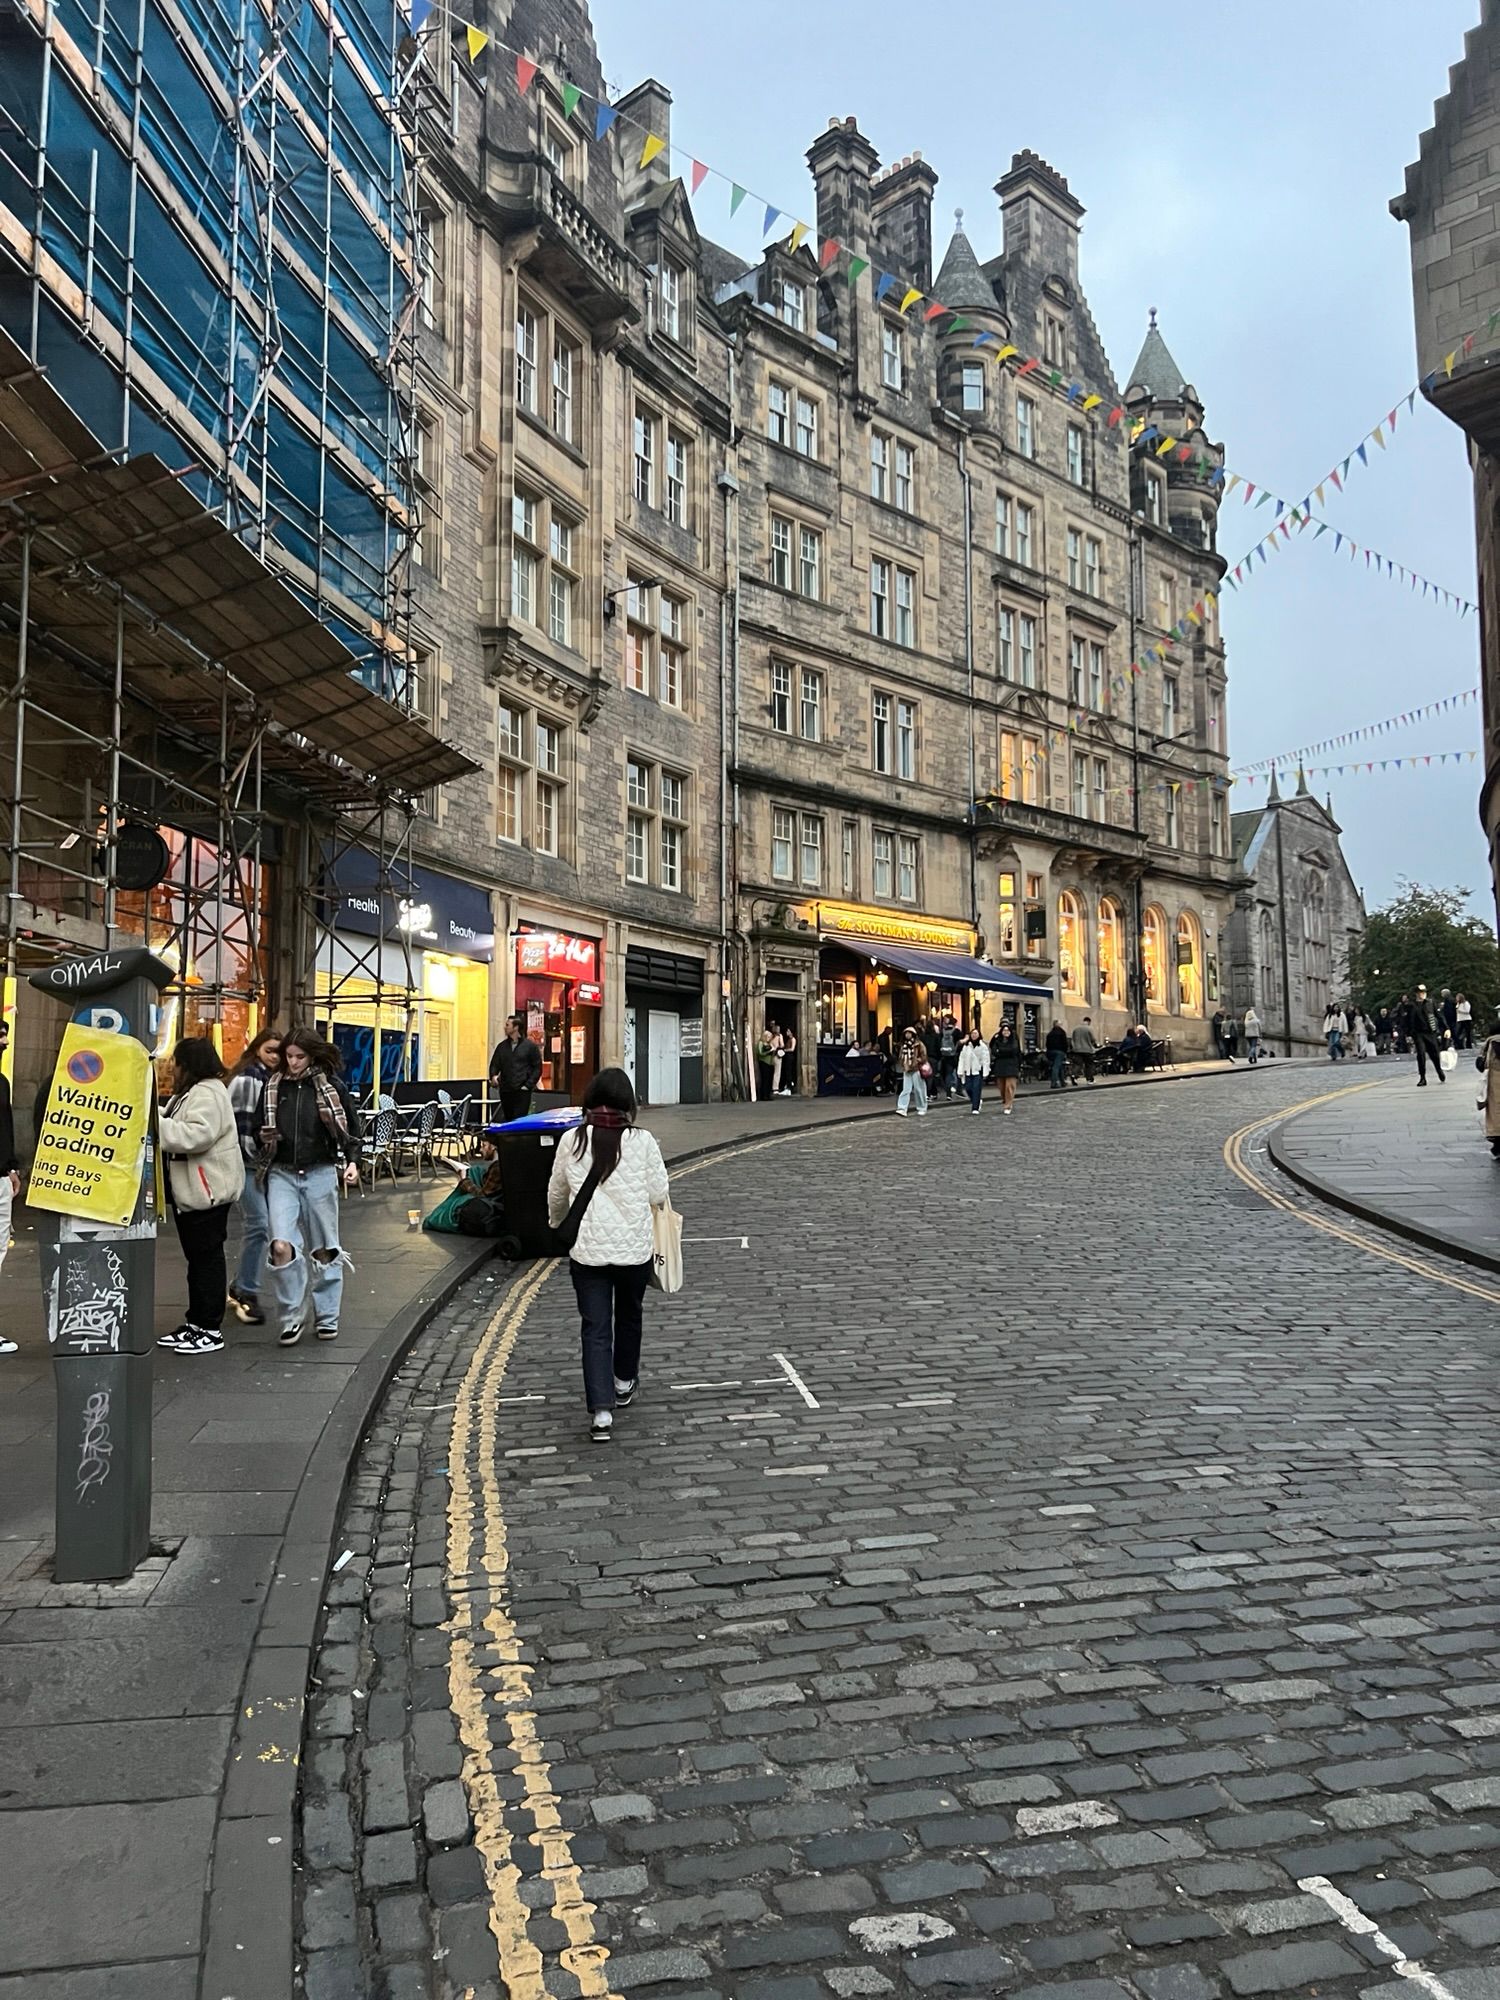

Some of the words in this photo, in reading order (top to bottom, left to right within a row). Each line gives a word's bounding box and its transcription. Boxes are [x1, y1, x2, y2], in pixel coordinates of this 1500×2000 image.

[348, 892, 380, 915] Health
[449, 920, 476, 943] Beauty
[837, 917, 855, 931] The
[856, 920, 918, 940] SCOTSMAN'S
[919, 930, 958, 947] LOUNGE
[50, 955, 122, 987] OMAL
[56, 1085, 133, 1121] Waiting
[104, 1124, 127, 1139] or
[65, 1164, 102, 1183] Bays
